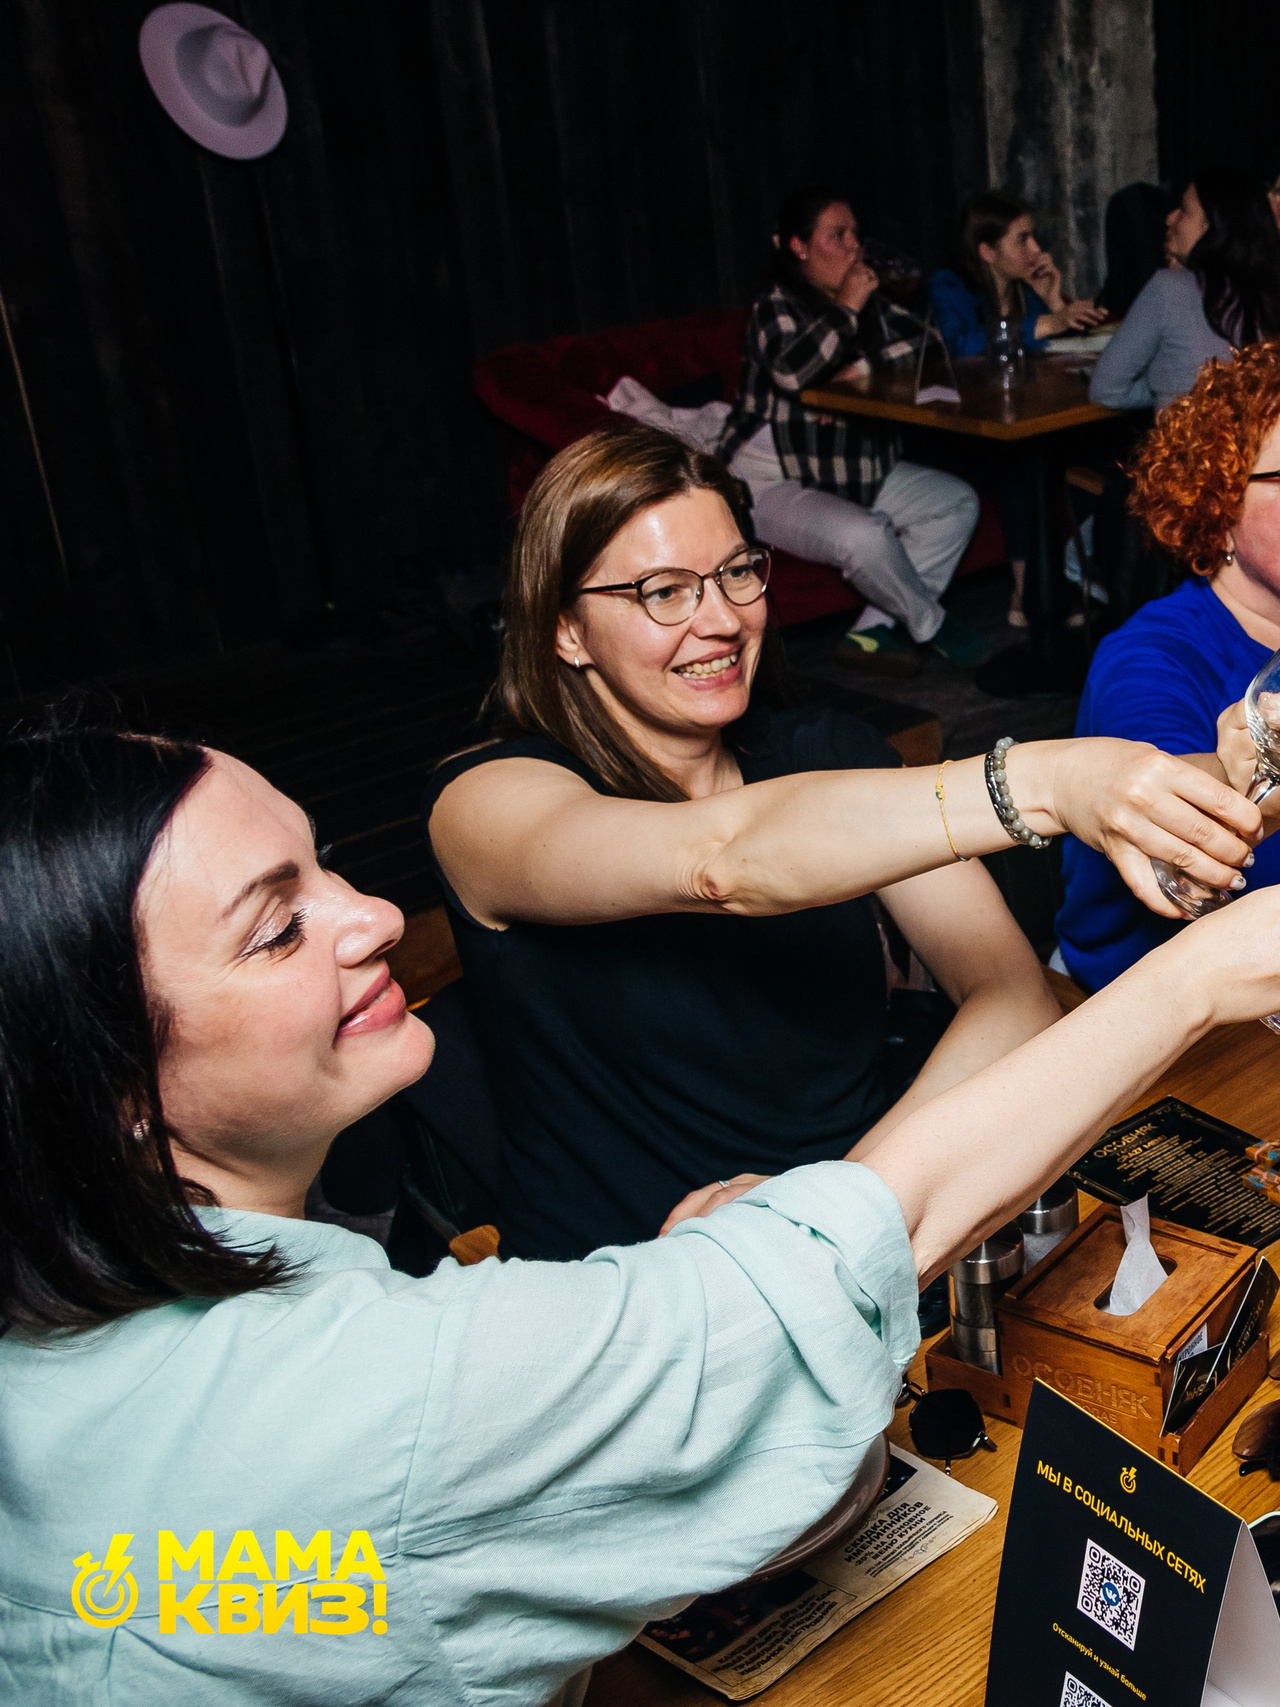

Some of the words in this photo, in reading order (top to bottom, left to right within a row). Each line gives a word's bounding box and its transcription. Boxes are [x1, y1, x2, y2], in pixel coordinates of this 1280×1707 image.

[1011, 1353, 1152, 1419] ОСОБНЯК
[844, 1518, 888, 1554] СКИДКА
[886, 1502, 911, 1520] ДЛЯ
[844, 1501, 924, 1563] ИМЕНИННИКОВ
[871, 1538, 898, 1561] МЕНЮ
[897, 1517, 926, 1539] КУХНИ
[873, 1540, 887, 1551] НА
[886, 1505, 932, 1539] ОСНОВНОЕ
[1037, 1460, 1061, 1486] МЫ
[1063, 1476, 1073, 1493] В
[1074, 1485, 1165, 1561] СОЦИАЛЬНЫХ
[1166, 1551, 1207, 1594] СЕТЯХ
[1052, 1622, 1093, 1658] Отсканируй
[1093, 1654, 1099, 1663] и
[1099, 1659, 1120, 1679] узнай
[1120, 1674, 1147, 1701] больше
